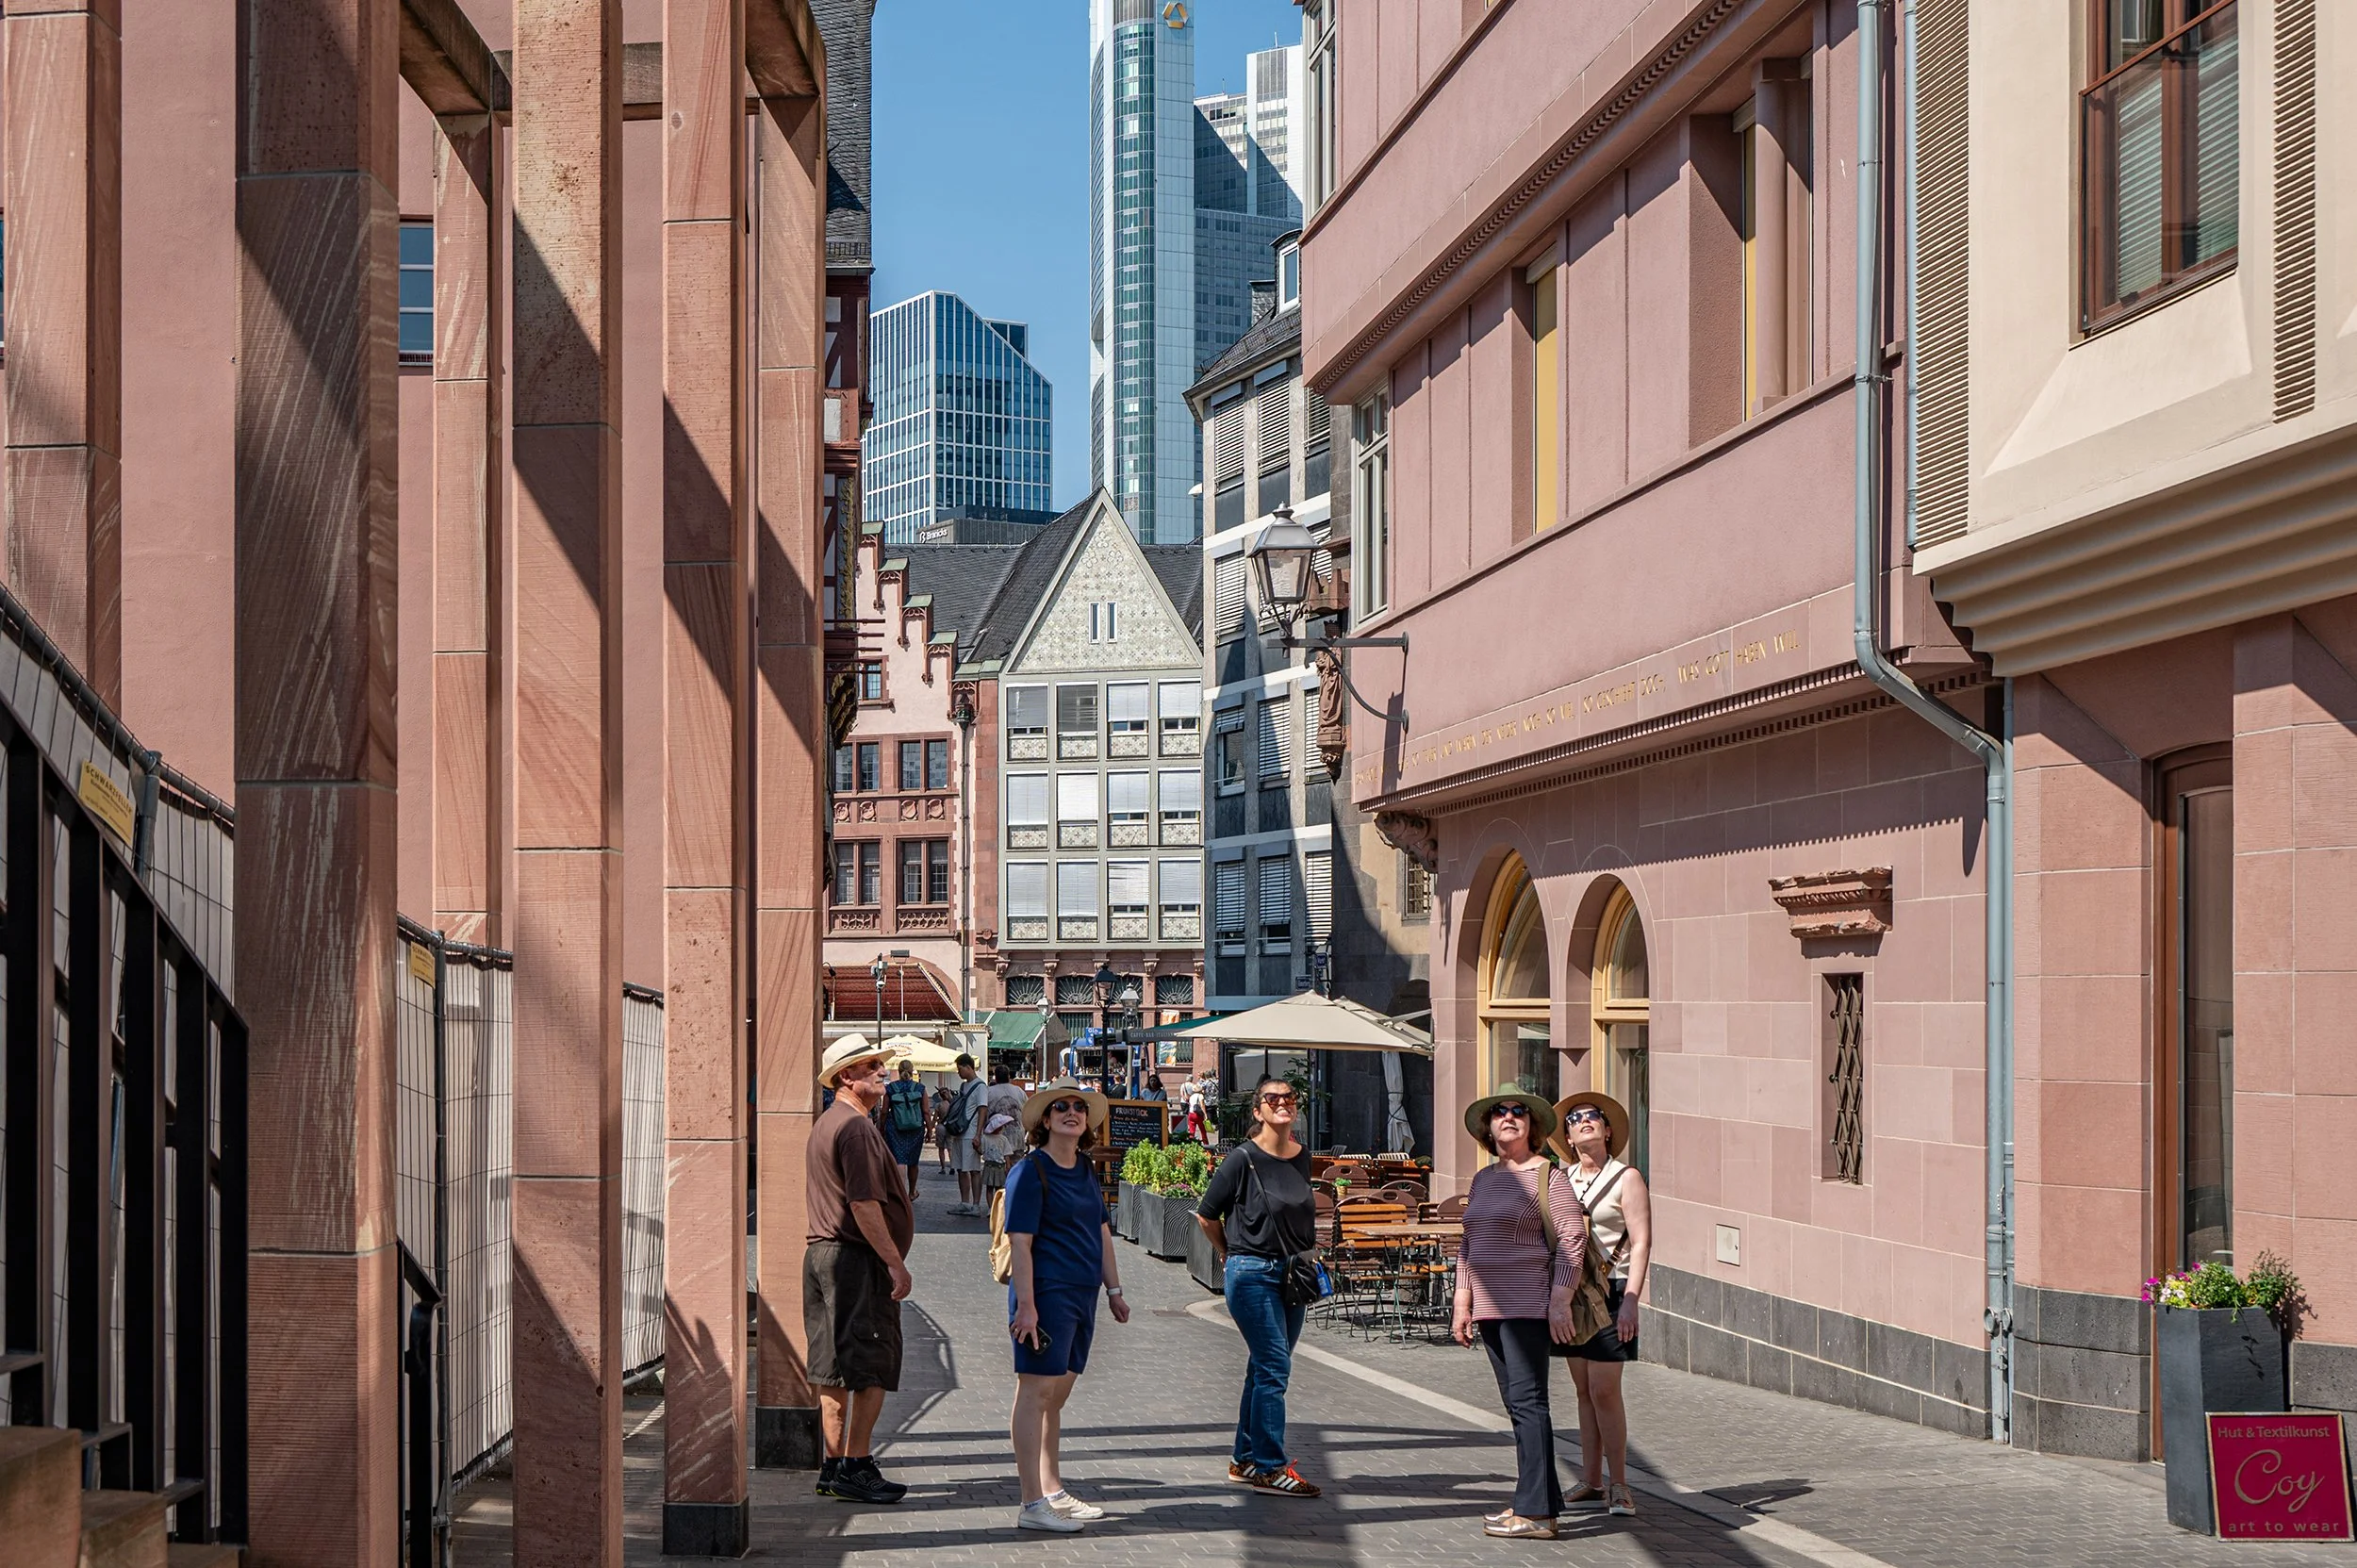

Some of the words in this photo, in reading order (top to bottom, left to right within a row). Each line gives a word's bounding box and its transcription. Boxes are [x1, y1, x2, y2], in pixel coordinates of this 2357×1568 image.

[1677, 660, 1700, 684] WAS
[1705, 650, 1730, 675] GOTT
[1735, 639, 1768, 668] HABEN
[2217, 1427, 2244, 1438] Hut
[2246, 1428, 2256, 1438] &
[2256, 1426, 2331, 1438] Textilkunst
[2233, 1448, 2325, 1513] Coy
[2229, 1521, 2256, 1532] art
[2265, 1521, 2284, 1532] to
[2293, 1522, 2339, 1532] wear
